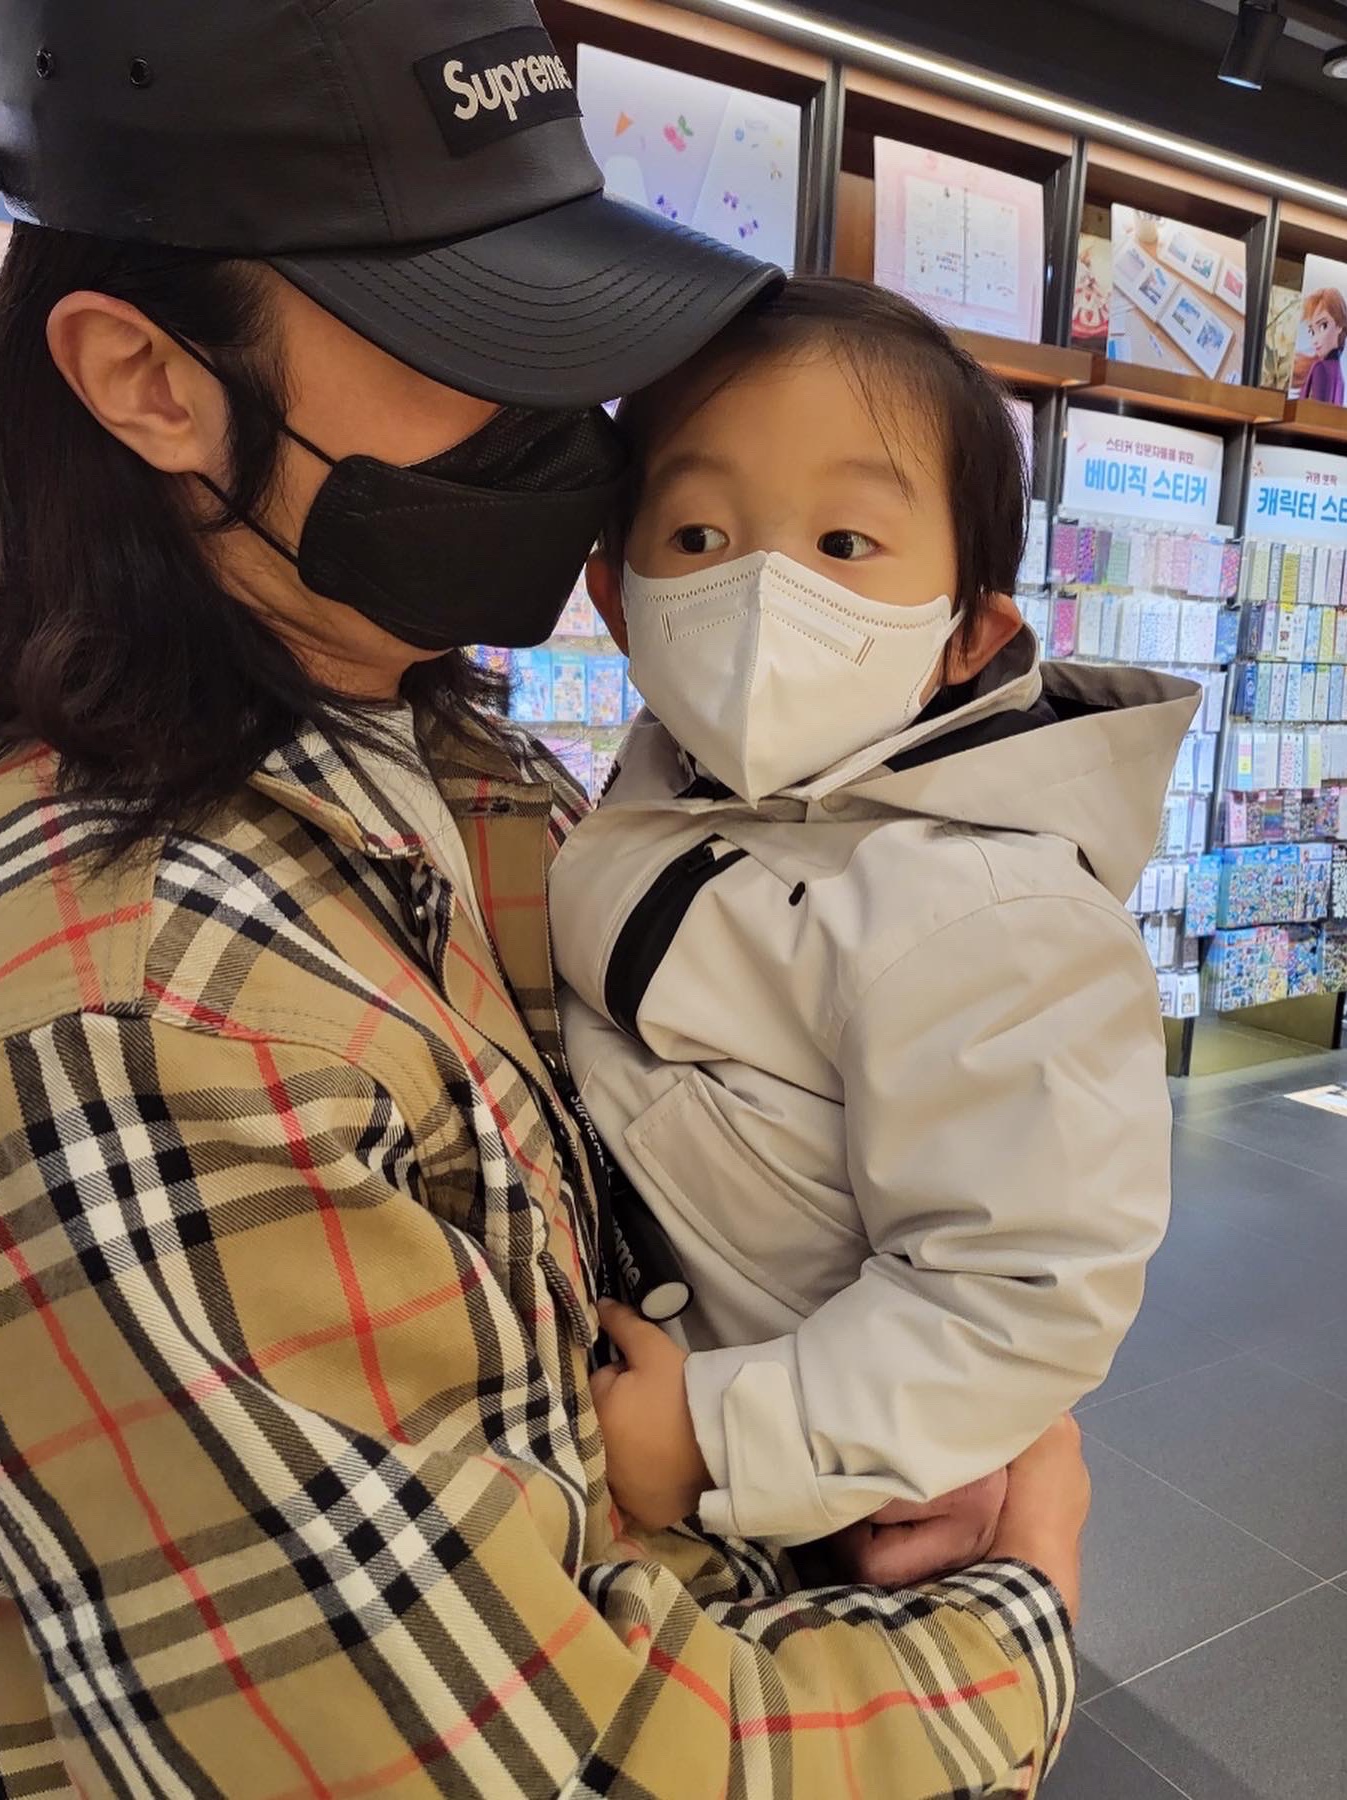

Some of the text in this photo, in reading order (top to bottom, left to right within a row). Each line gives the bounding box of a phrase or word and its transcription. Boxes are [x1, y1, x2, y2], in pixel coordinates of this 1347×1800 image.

[443, 55, 573, 122] Supreme
[1106, 438, 1133, 453] 스티커
[1084, 458, 1208, 507] 베이직 스티커
[1257, 487, 1317, 521] 캐릭터
